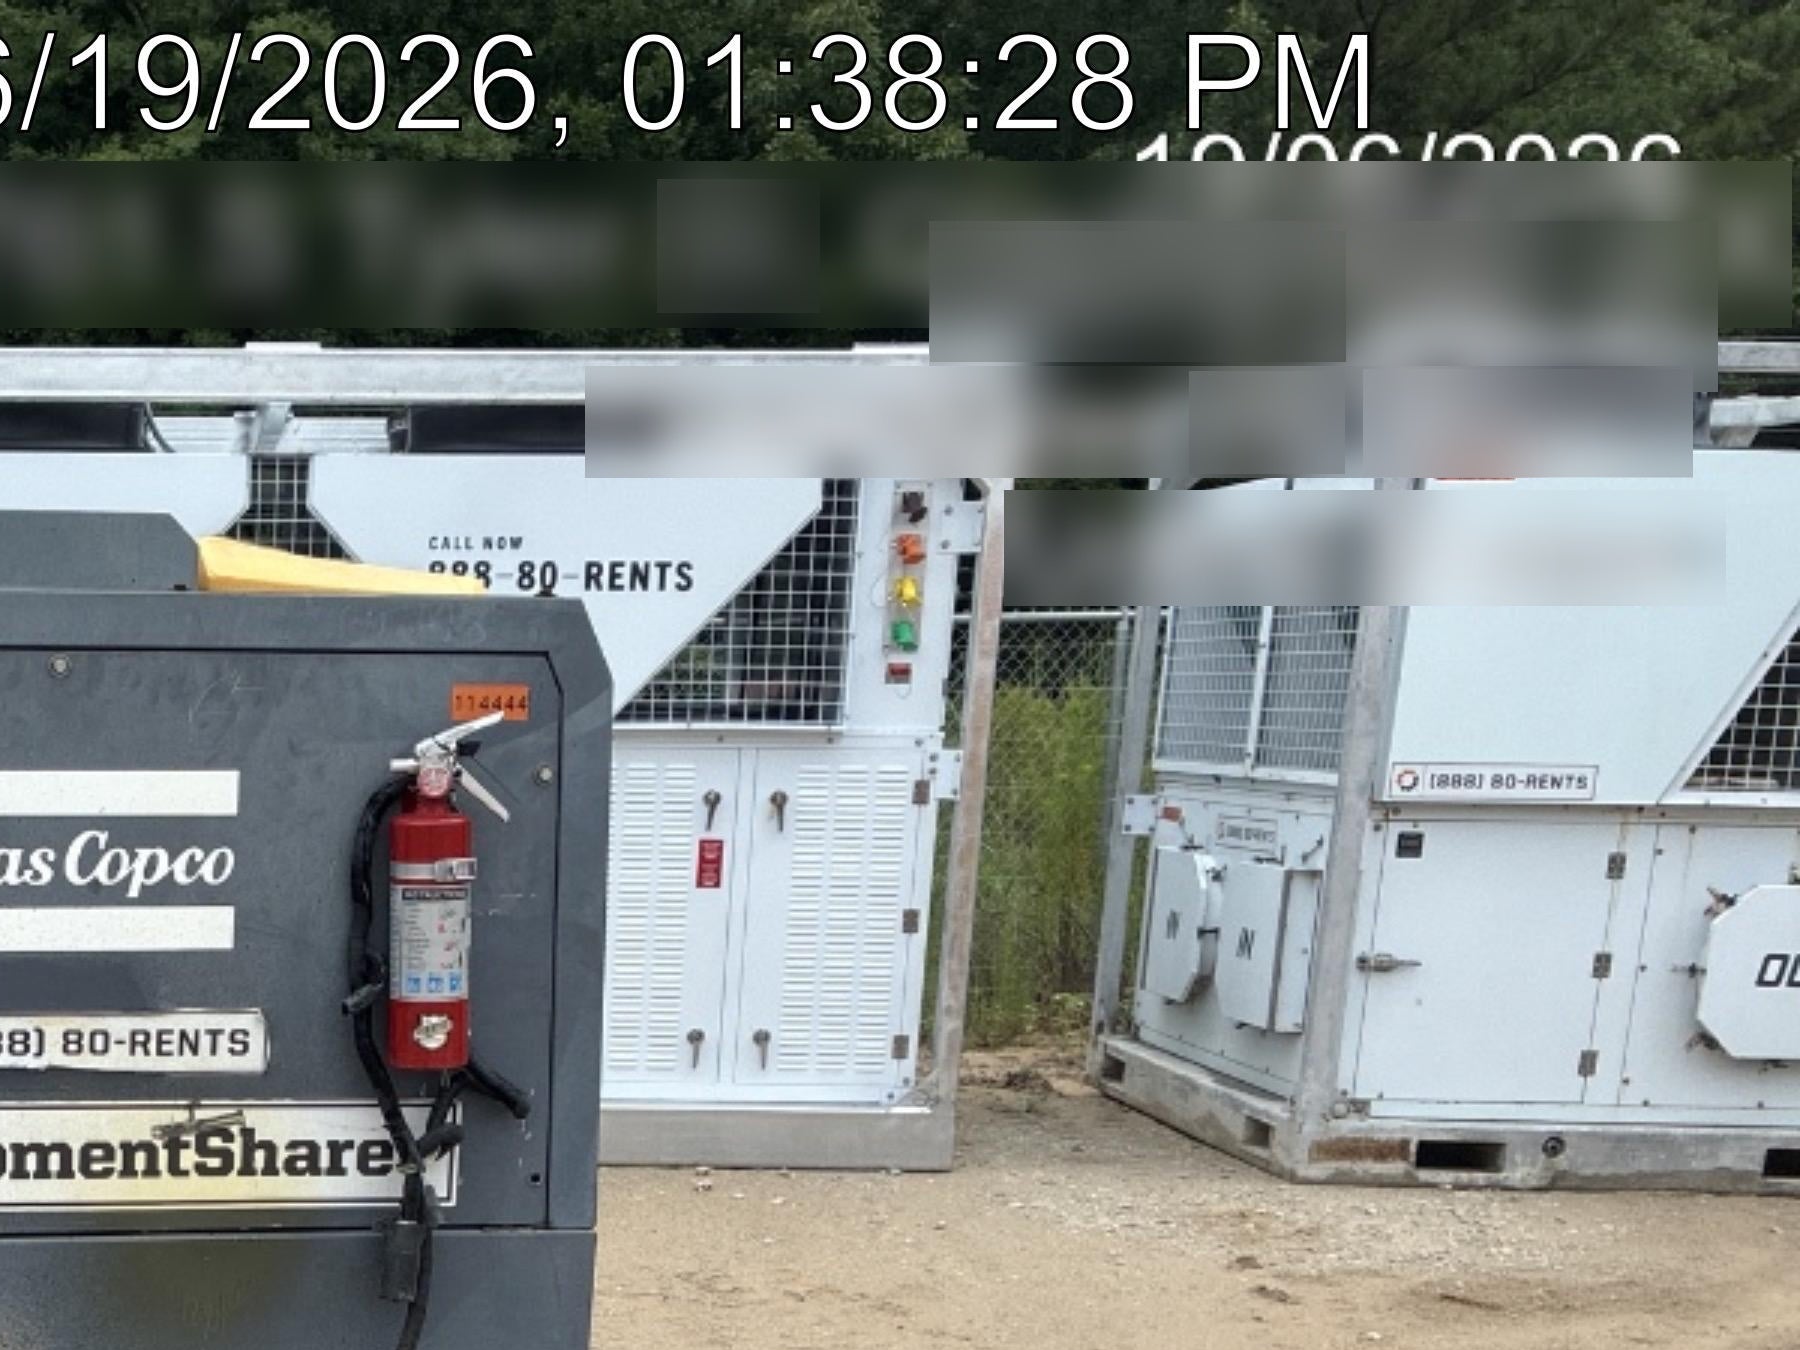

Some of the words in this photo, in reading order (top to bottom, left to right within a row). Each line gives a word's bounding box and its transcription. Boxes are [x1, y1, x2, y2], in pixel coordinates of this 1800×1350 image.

[428, 536, 474, 550] CALL
[482, 537, 523, 550] NOW
[455, 695, 528, 713] 114444
[1490, 774, 1588, 790] 80-RENTS
[64, 830, 235, 898] Copco
[62, 1028, 251, 1058] 80-RENTS
